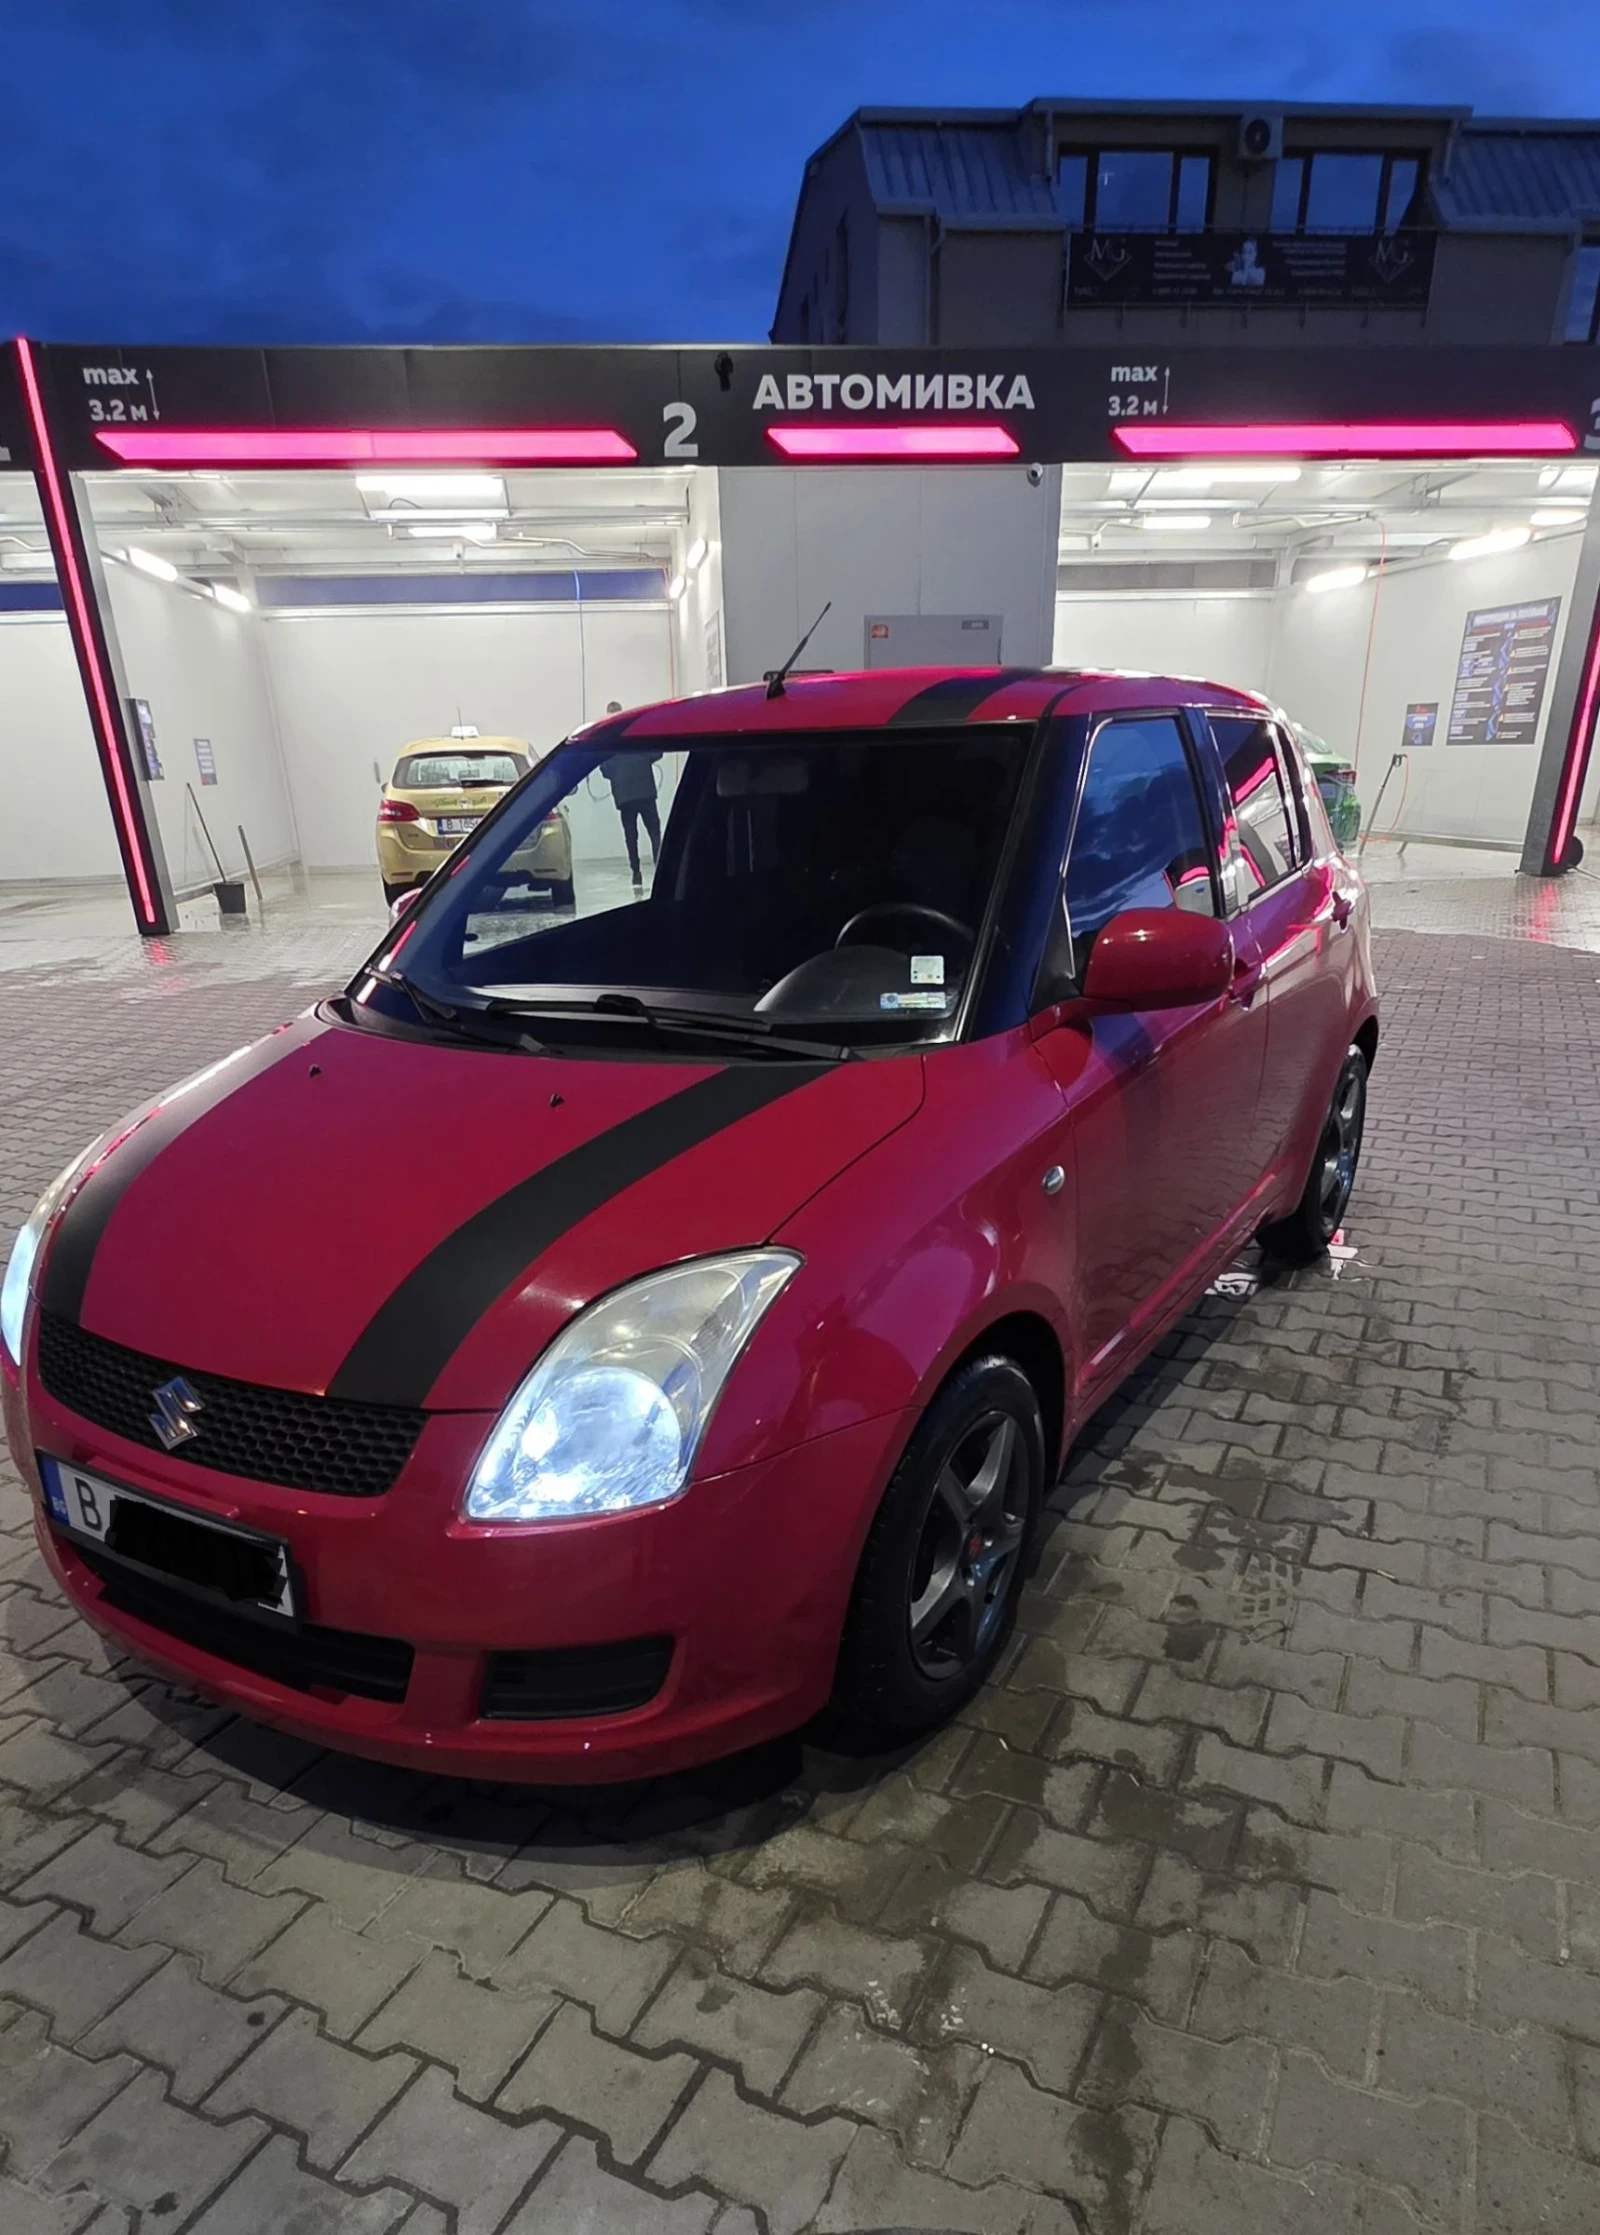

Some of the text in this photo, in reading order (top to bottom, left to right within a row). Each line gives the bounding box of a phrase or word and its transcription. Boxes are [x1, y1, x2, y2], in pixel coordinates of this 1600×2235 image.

[83, 367, 139, 385] max
[1111, 366, 1158, 382] max
[752, 374, 1035, 410] АВТОМИВКА
[88, 399, 127, 421] 3.2
[1108, 395, 1139, 416] 3.2
[662, 402, 699, 458] 2
[74, 1477, 102, 1532] B
